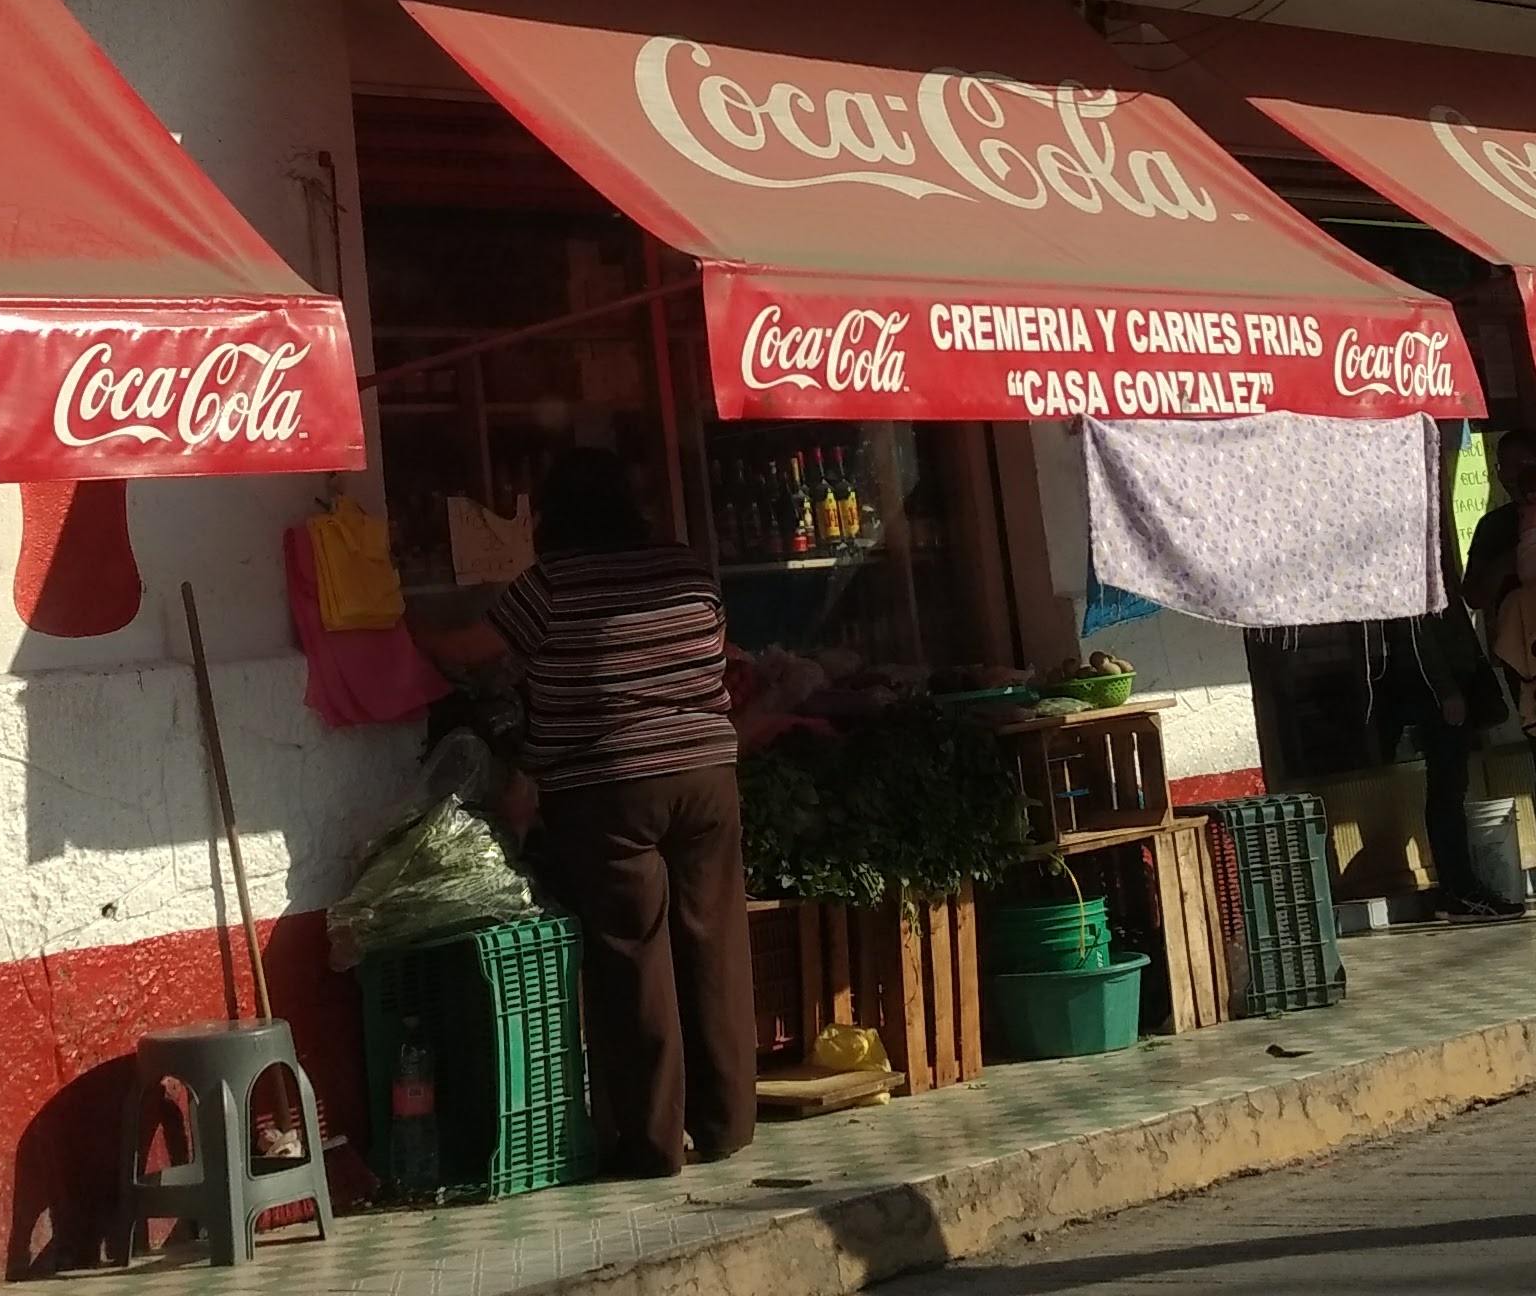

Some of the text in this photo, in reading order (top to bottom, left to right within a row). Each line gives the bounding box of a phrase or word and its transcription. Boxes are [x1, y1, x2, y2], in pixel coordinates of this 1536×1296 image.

[635, 35, 1217, 222] Coca-Cola
[741, 304, 910, 393] Coca-Cola
[930, 303, 1323, 358] CREMERIA Y CARNES FRIAS
[1334, 327, 1455, 397] Coca-Cola
[53, 342, 312, 447] Coca-Cola
